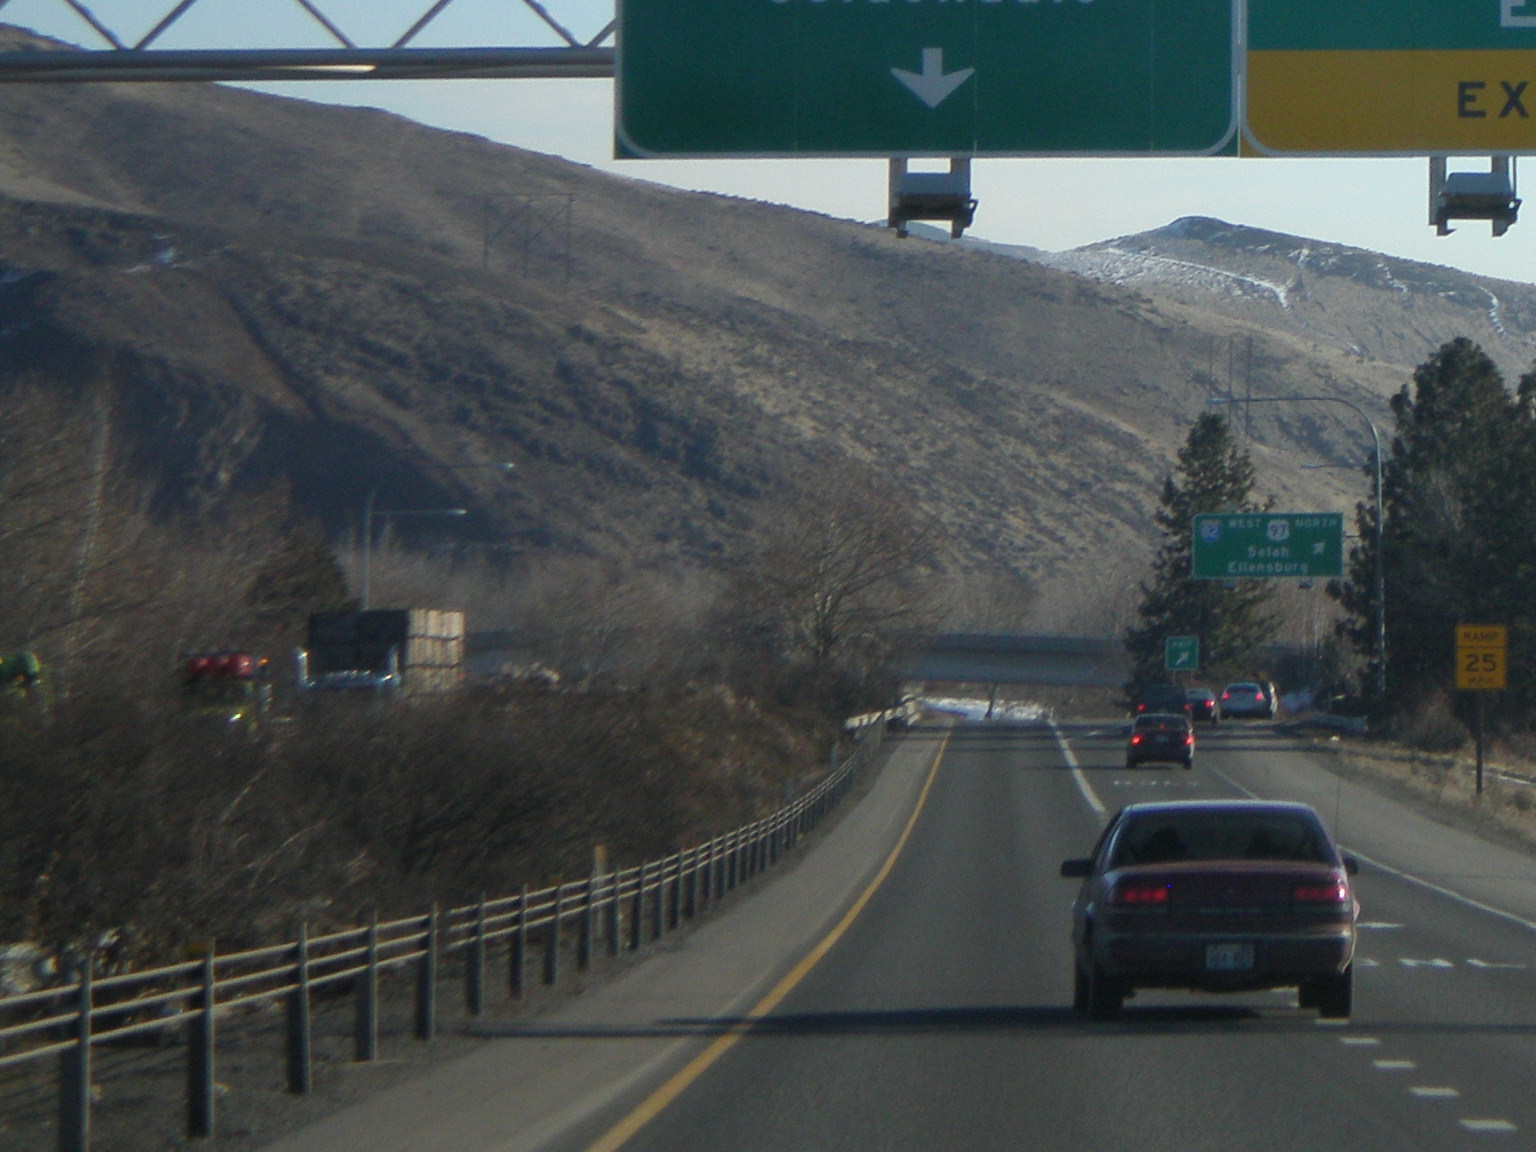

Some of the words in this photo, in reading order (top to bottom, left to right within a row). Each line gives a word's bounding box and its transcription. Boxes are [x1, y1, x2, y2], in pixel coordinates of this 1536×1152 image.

[1229, 519, 1261, 528] WEST
[1270, 524, 1287, 537] 97
[1248, 545, 1290, 558] Selah
[1228, 561, 1309, 574] Ellensburg
[1465, 653, 1497, 673] 25
